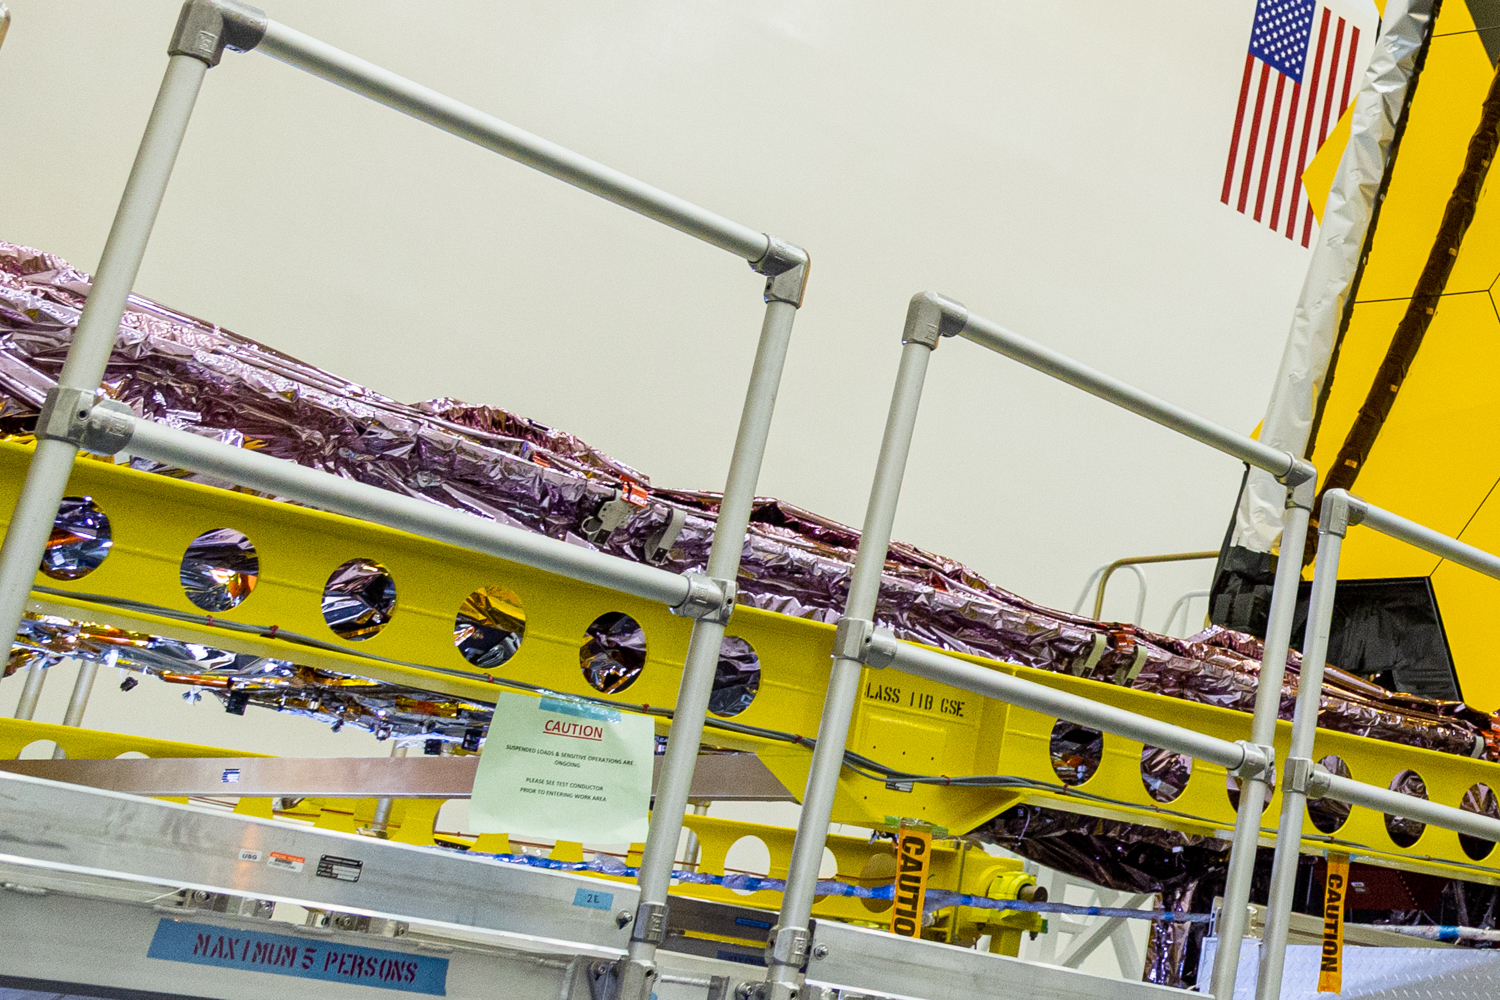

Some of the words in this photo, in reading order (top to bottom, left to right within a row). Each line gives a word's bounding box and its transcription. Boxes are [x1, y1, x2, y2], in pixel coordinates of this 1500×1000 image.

[865, 682, 901, 703] LASS
[940, 698, 965, 717] GSE
[544, 719, 603, 740] CAUTION
[506, 744, 536, 754] SUSPENDED
[537, 748, 555, 757] LOADS
[561, 752, 586, 761] SENSITIVE
[587, 755, 622, 765] OPERATIONS
[554, 760, 581, 768] ONGOING
[526, 777, 545, 785] PLEASE
[569, 782, 604, 792] CONDUCTOR
[546, 790, 573, 799] ENTERING
[574, 793, 592, 801] WORK
[893, 835, 926, 937] CAUTIO
[1320, 873, 1343, 972] CAUTION
[193, 933, 298, 968] MAXIMUM
[301, 948, 317, 970] 5
[324, 951, 418, 983] PERSONS
